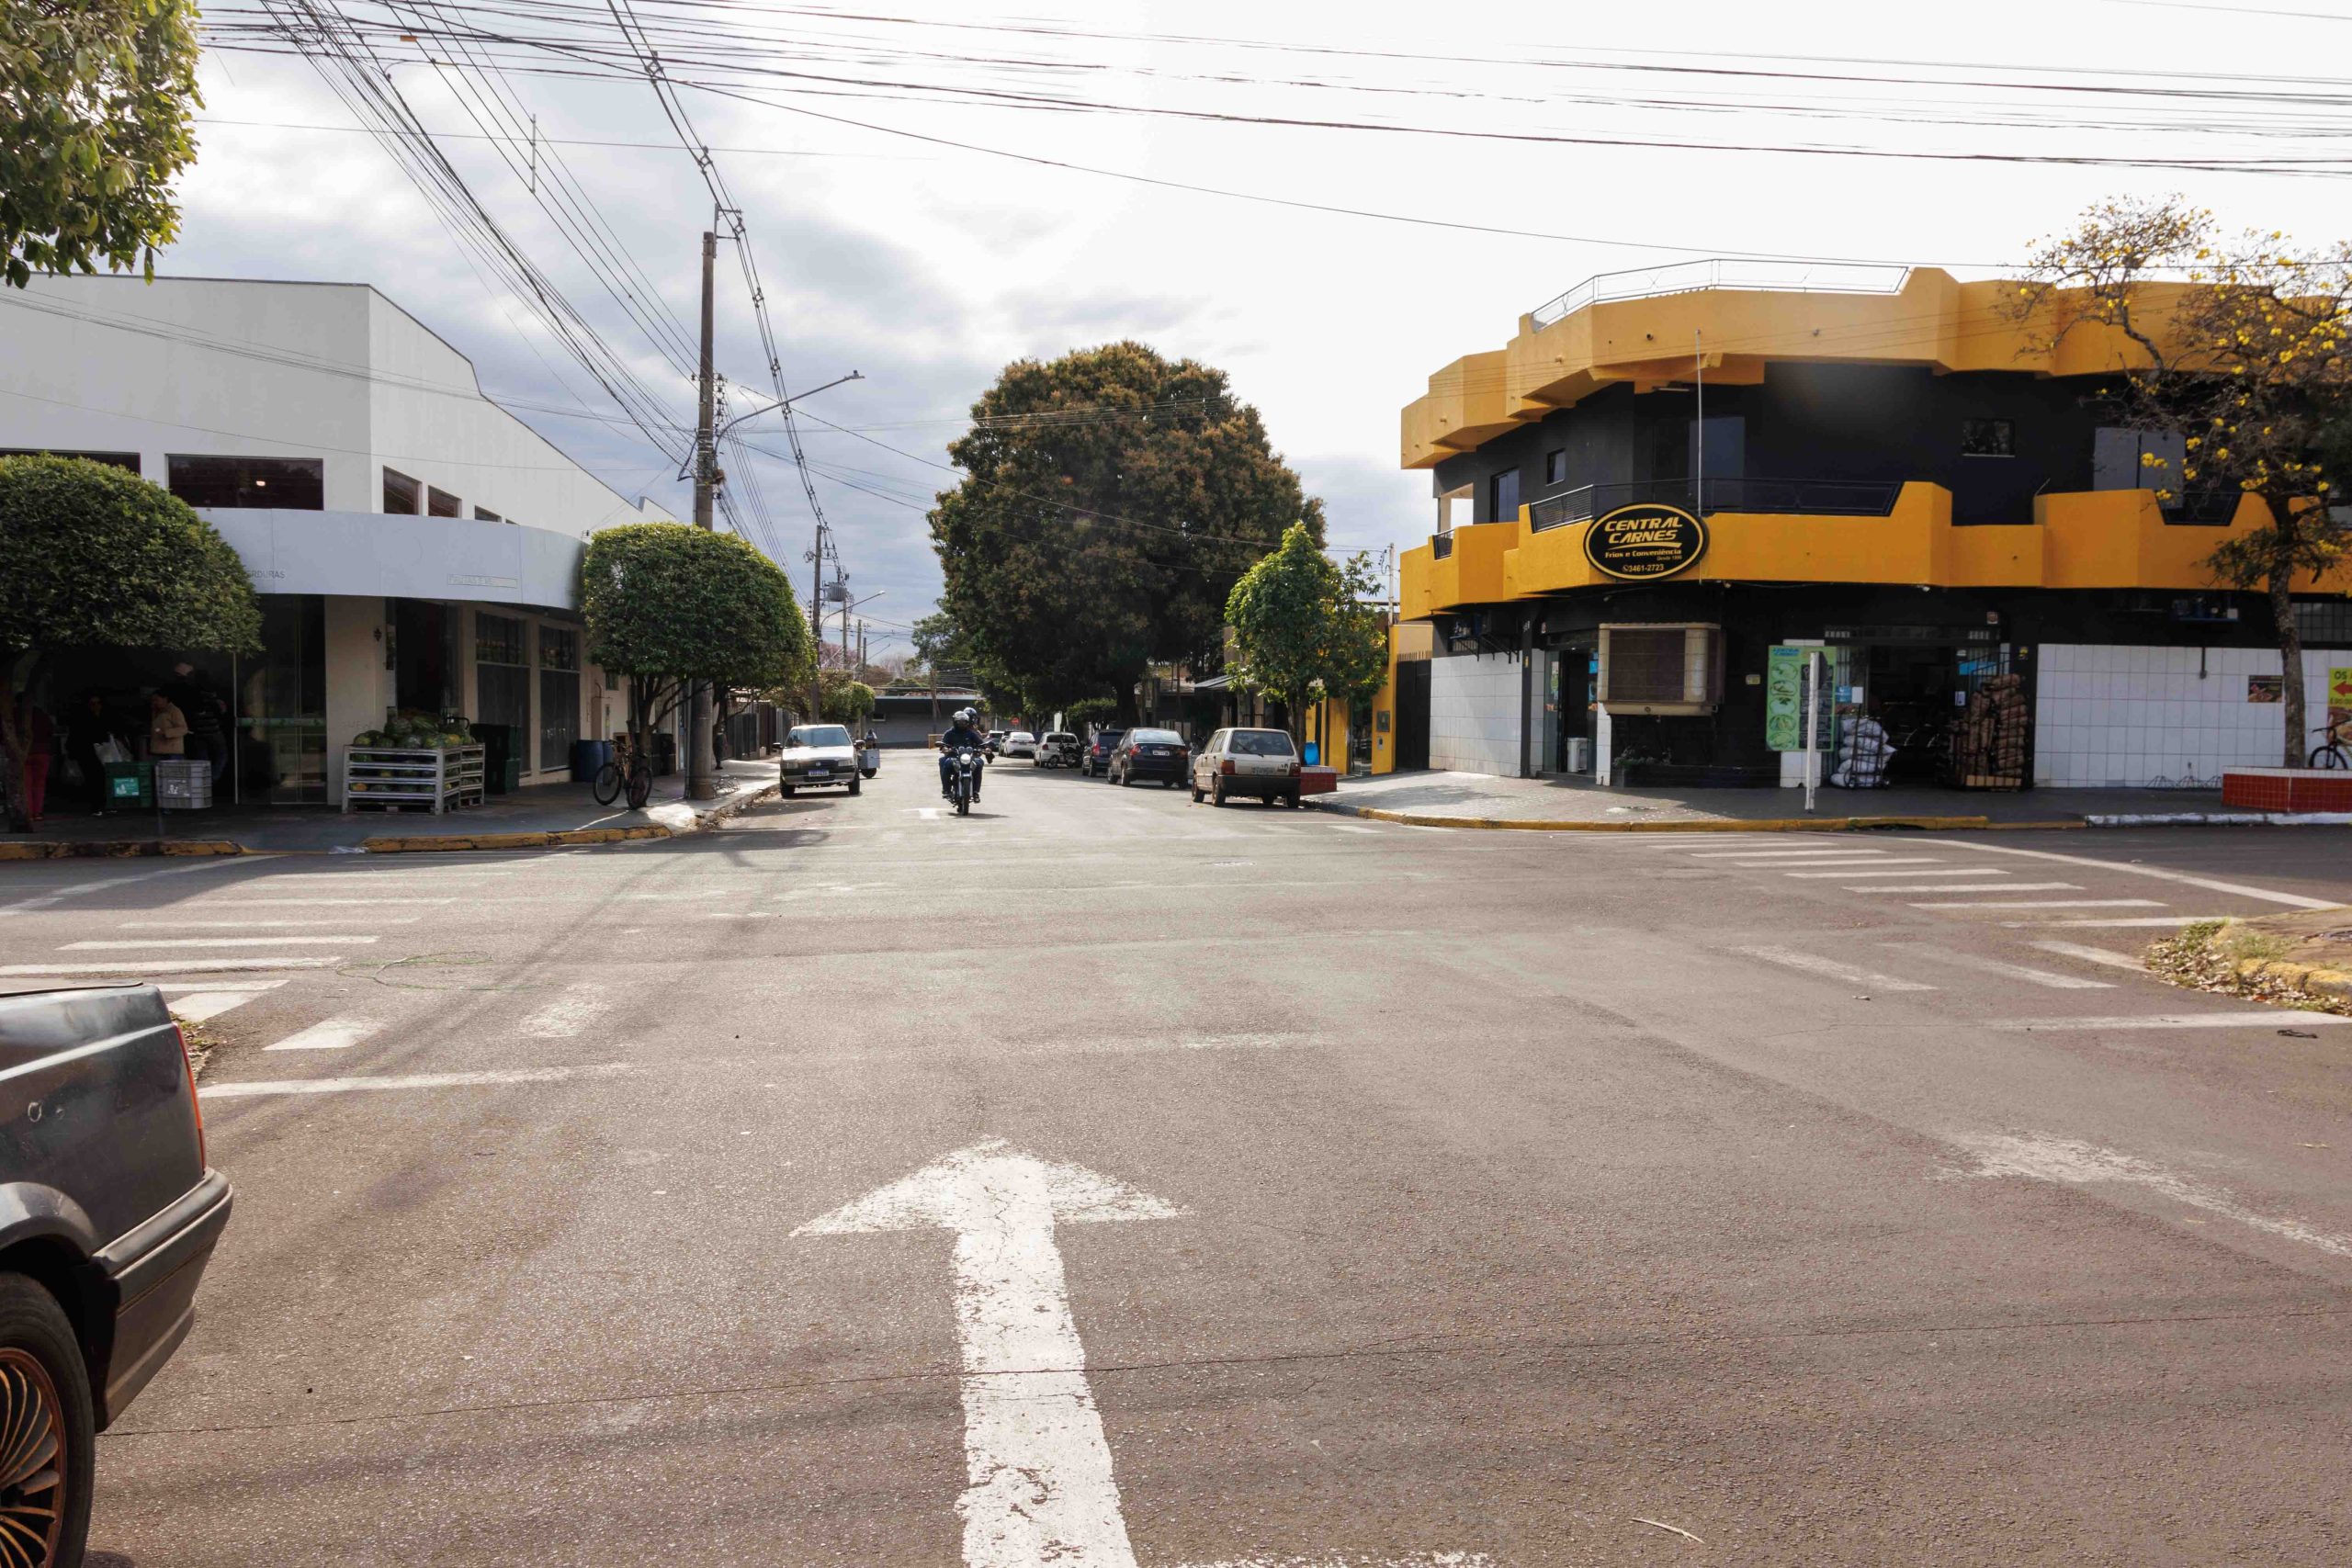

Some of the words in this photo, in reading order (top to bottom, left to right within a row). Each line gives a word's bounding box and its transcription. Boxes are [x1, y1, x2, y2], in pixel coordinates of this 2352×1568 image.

[1604, 516, 1683, 531] CENTRAL
[1609, 529, 1678, 543] CARNES
[1632, 548, 1681, 557] Conveniência
[1628, 563, 1664, 572] 3461-2723
